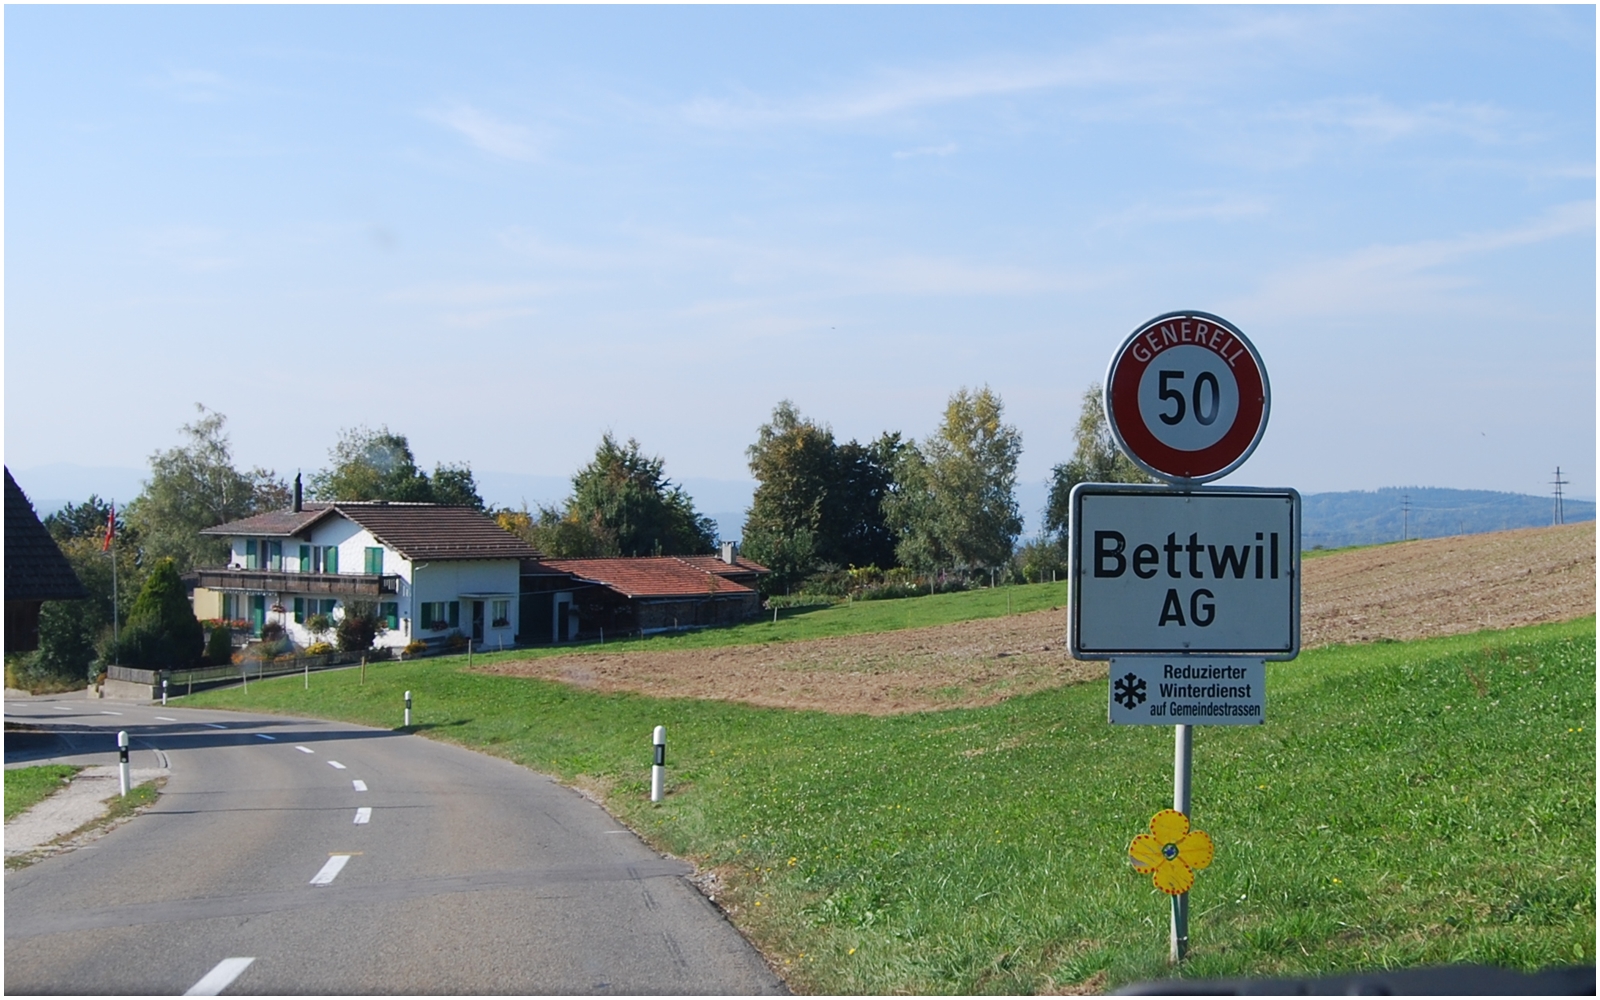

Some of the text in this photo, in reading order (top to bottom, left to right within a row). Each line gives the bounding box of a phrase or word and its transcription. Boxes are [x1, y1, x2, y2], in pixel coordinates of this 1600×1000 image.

[1132, 321, 1244, 367] GENERELL
[1158, 370, 1220, 426] 50
[1094, 530, 1279, 579] Bettwil
[1158, 588, 1216, 627] AG
[1159, 683, 1251, 698] Winterdienst
[1163, 664, 1247, 679] Reduzierter
[1150, 701, 1261, 716] auf Gemeindestrassen
